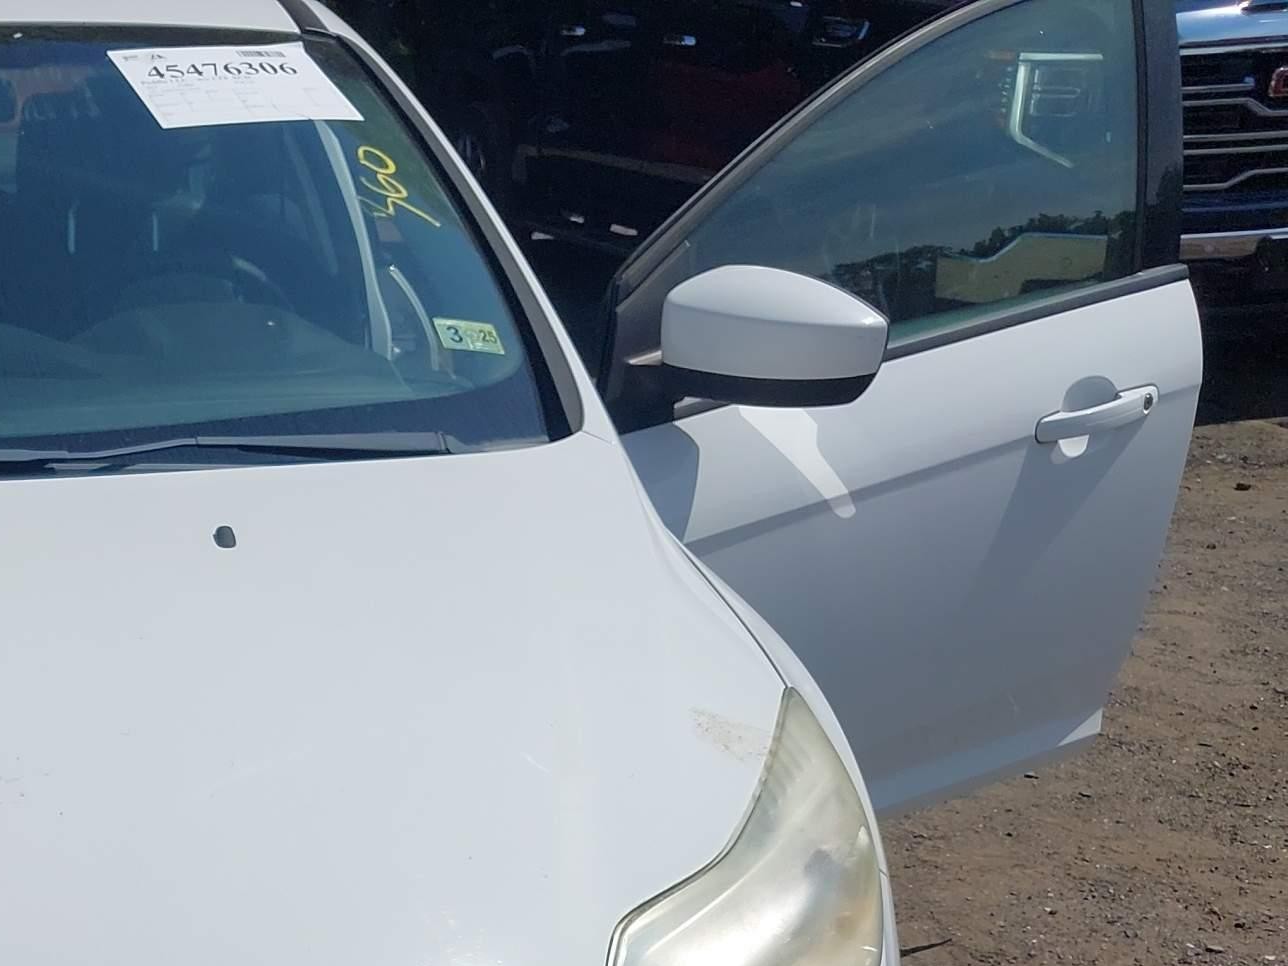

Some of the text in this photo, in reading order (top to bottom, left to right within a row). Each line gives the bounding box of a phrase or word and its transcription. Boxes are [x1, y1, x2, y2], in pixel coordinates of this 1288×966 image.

[147, 61, 298, 79] 45476306
[356, 145, 442, 228] 360
[445, 325, 464, 343] 3
